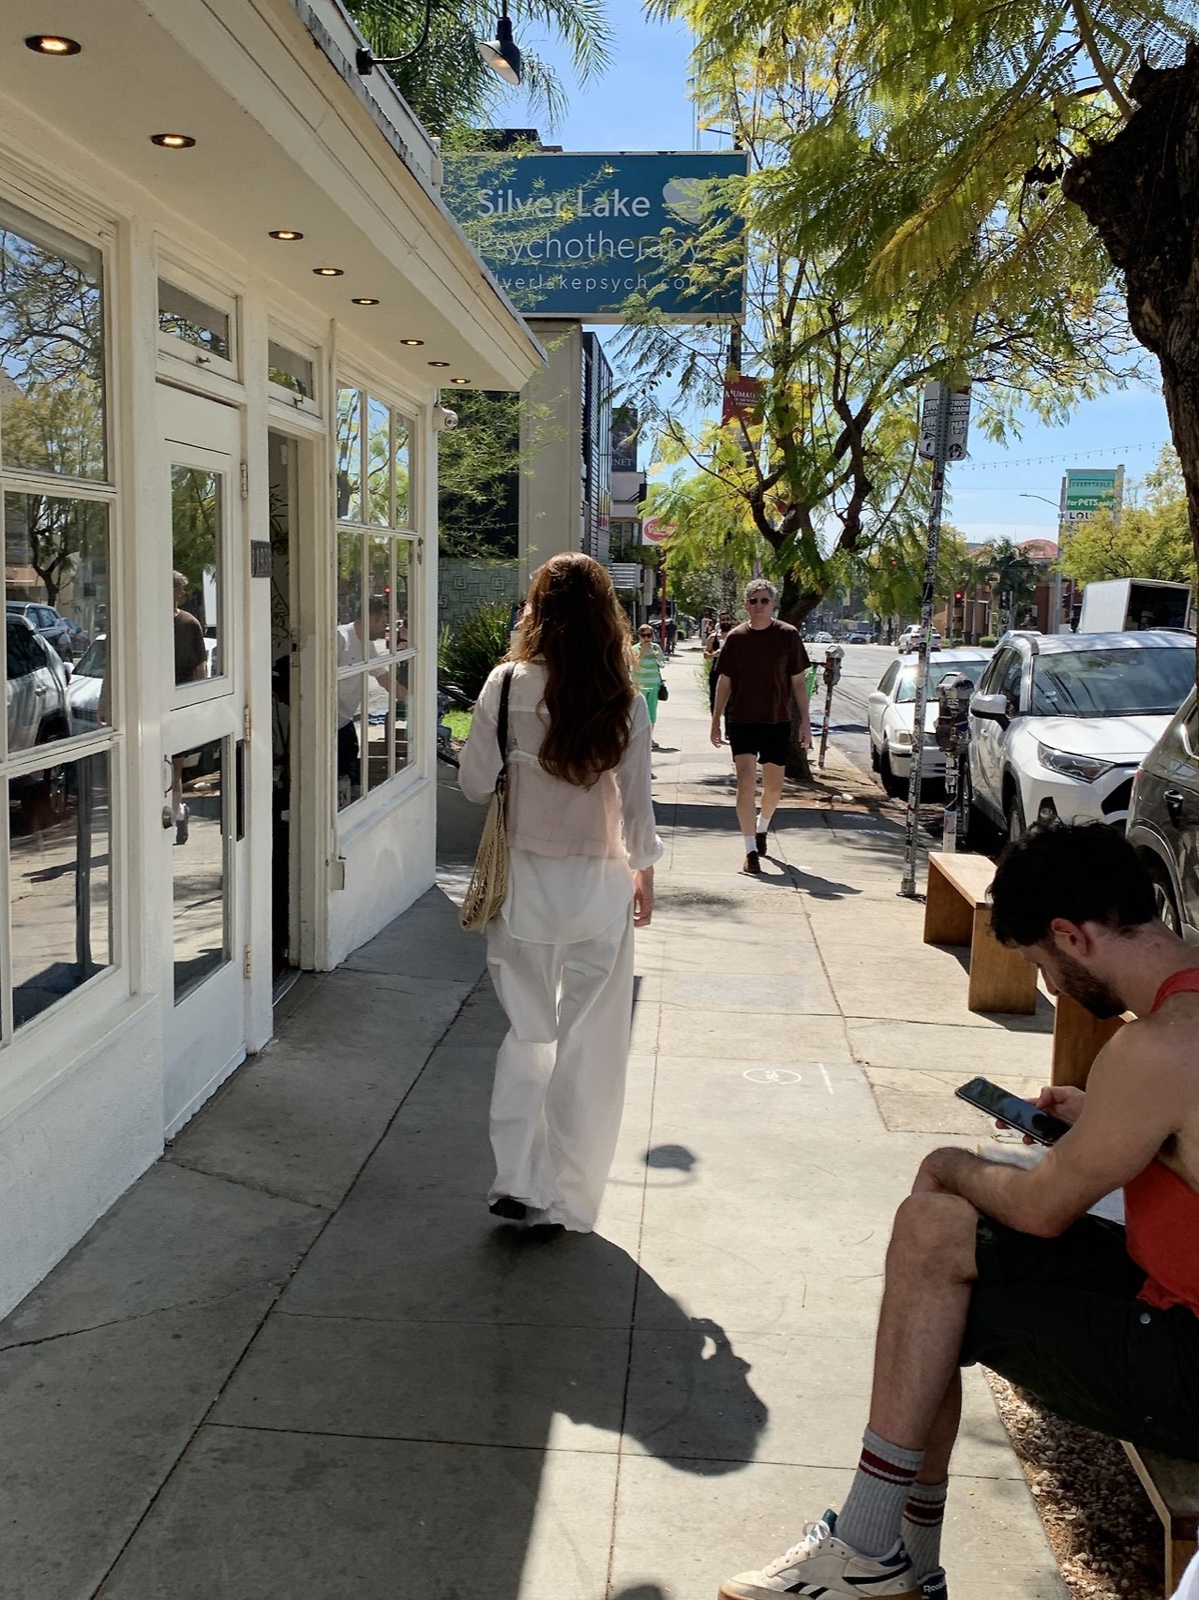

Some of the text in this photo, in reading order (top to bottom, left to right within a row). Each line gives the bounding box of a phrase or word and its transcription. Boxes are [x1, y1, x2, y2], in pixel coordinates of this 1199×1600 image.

[477, 188, 651, 218] Silver Lake
[1078, 498, 1098, 507] PETS
